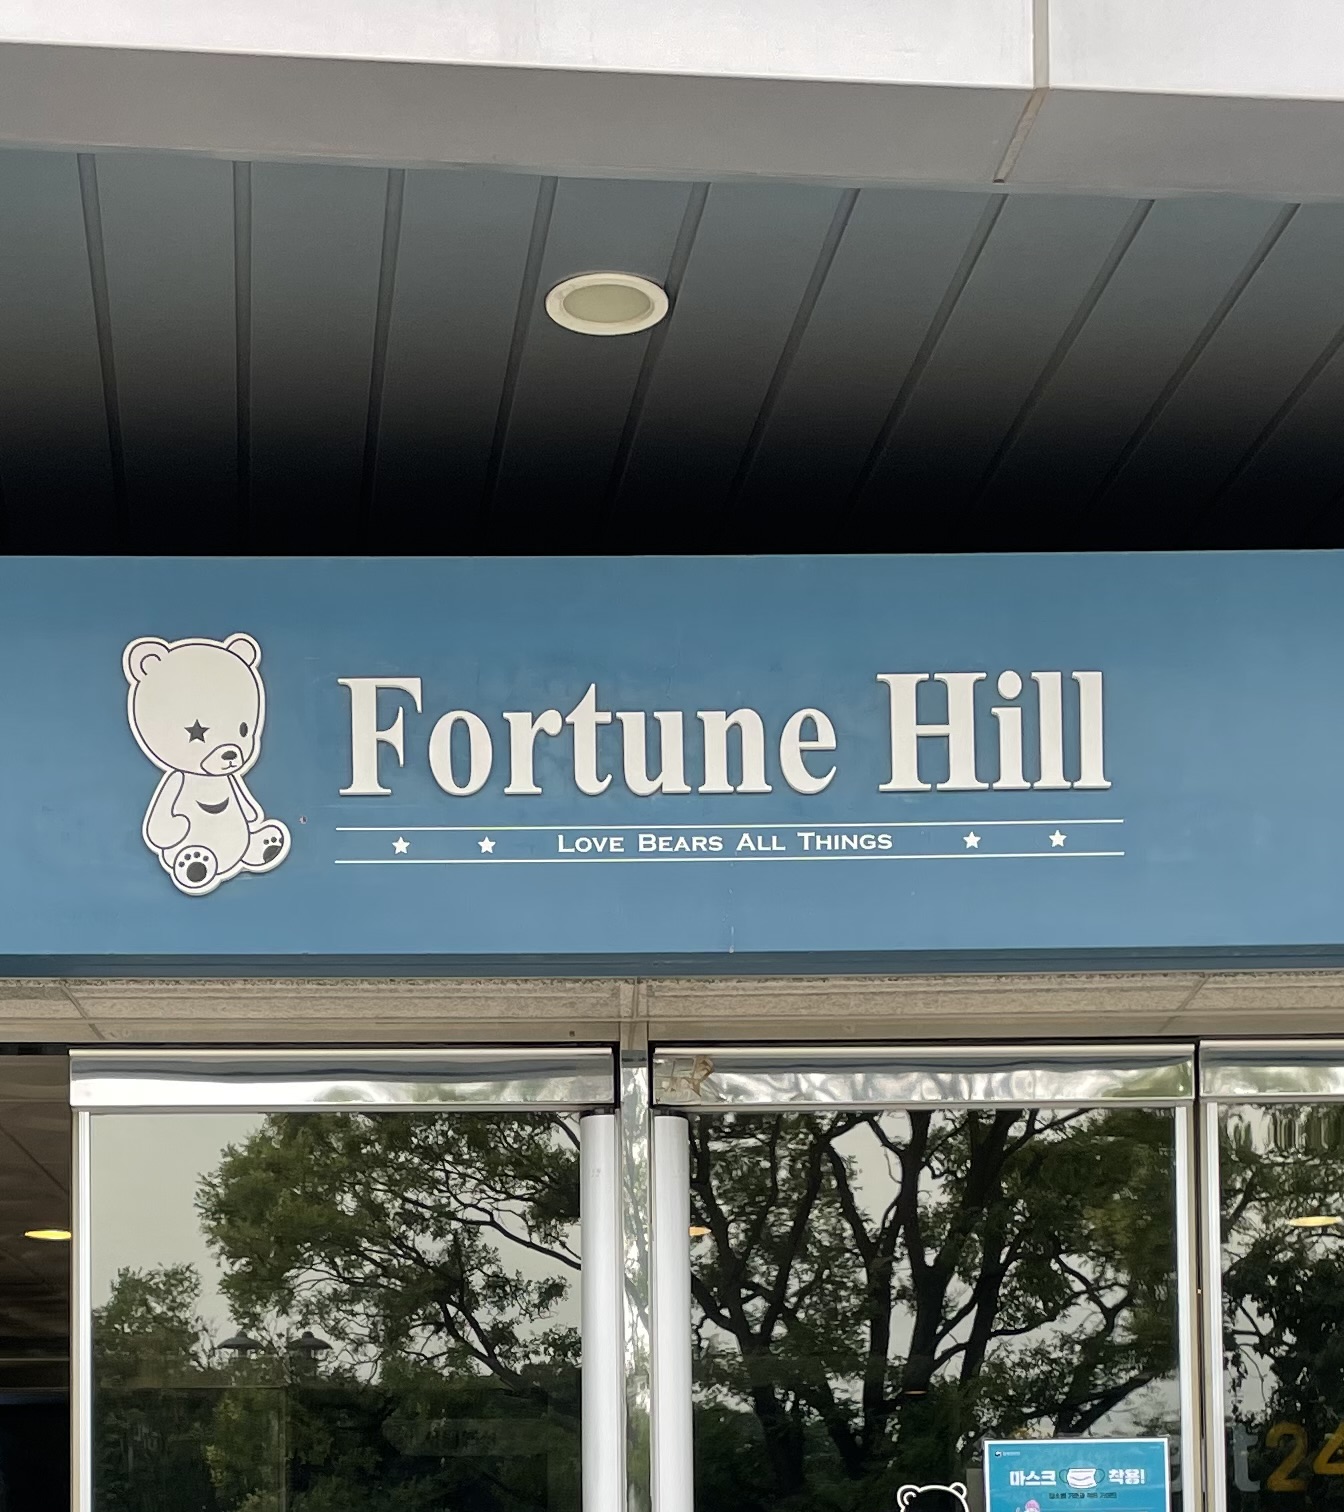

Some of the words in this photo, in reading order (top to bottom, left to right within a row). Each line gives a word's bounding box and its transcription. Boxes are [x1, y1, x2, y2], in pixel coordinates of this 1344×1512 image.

[337, 675, 837, 797] Fortune
[876, 669, 1112, 794] Hill
[736, 831, 786, 851] ALL
[1009, 1469, 1056, 1488] 마스크
[1108, 1468, 1146, 1487] 착용!
